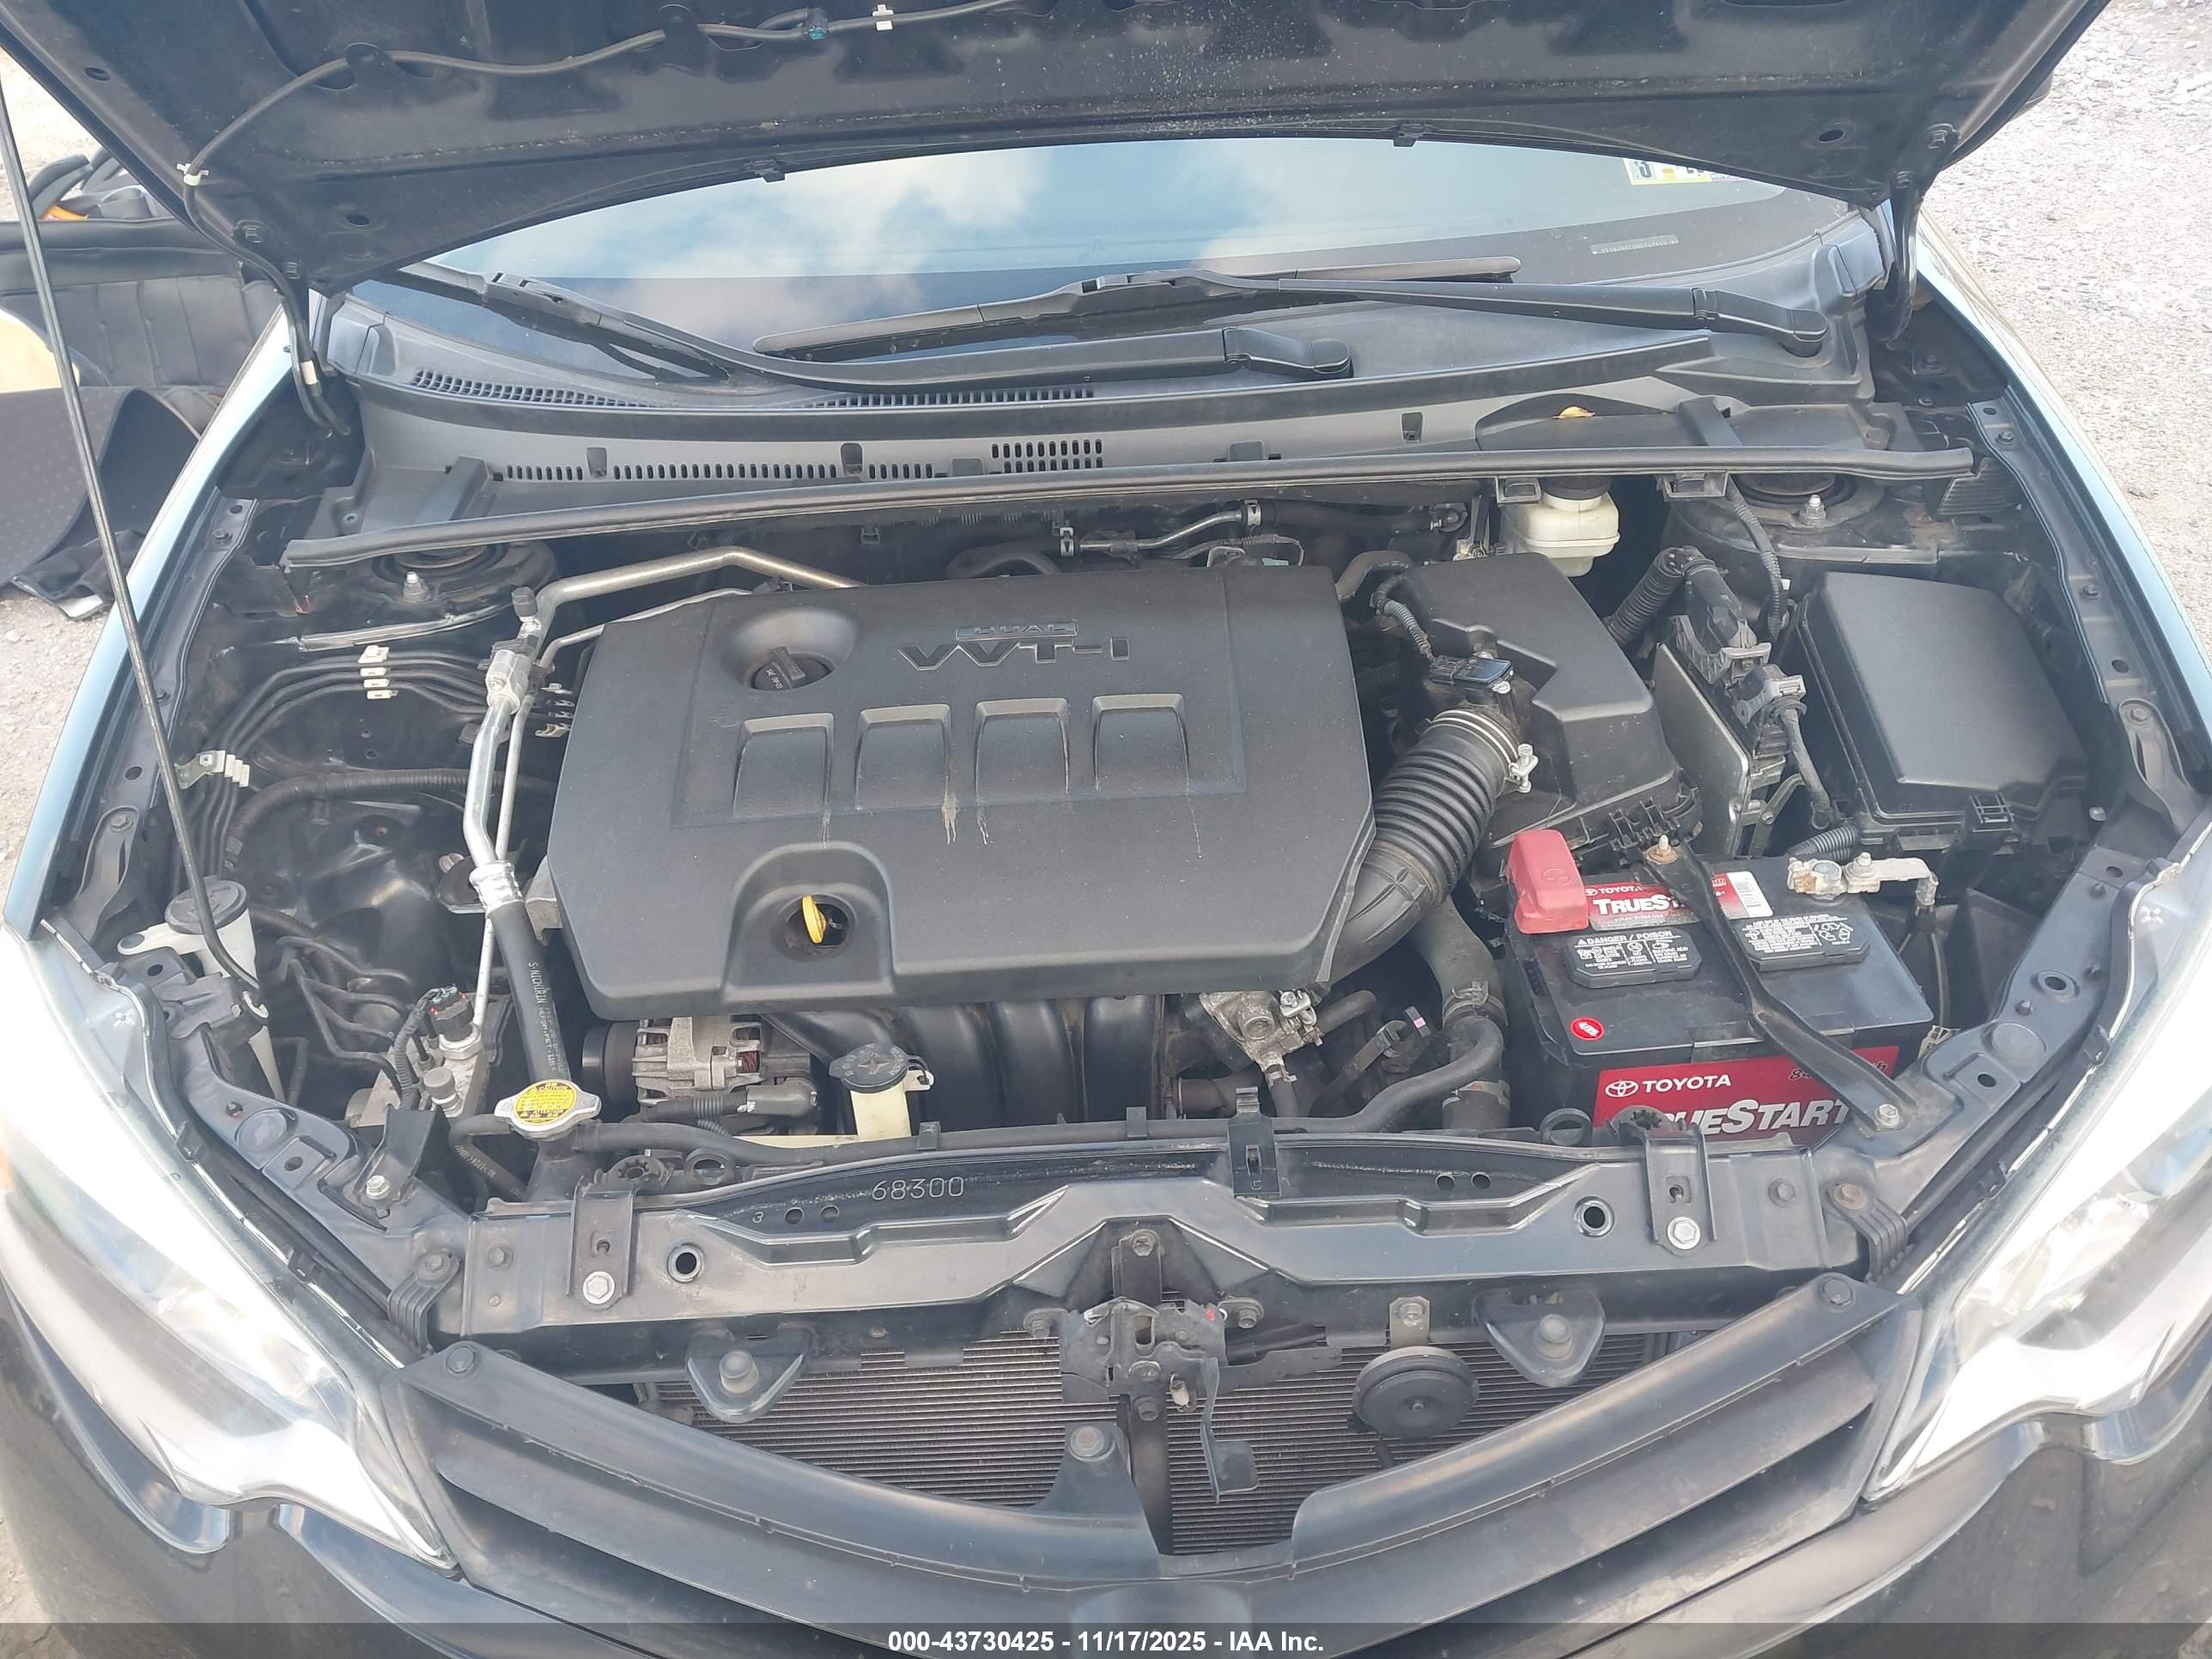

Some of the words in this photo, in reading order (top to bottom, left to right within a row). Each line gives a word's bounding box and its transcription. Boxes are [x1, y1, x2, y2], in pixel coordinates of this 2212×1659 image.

[1598, 885, 1644, 895] TOYOTA
[1587, 935, 1627, 945] DANGER
[1637, 930, 1673, 940] POISON
[1643, 1073, 1732, 1093] TOYOTA
[872, 1176, 964, 1201] 68300
[751, 1212, 765, 1224] 3
